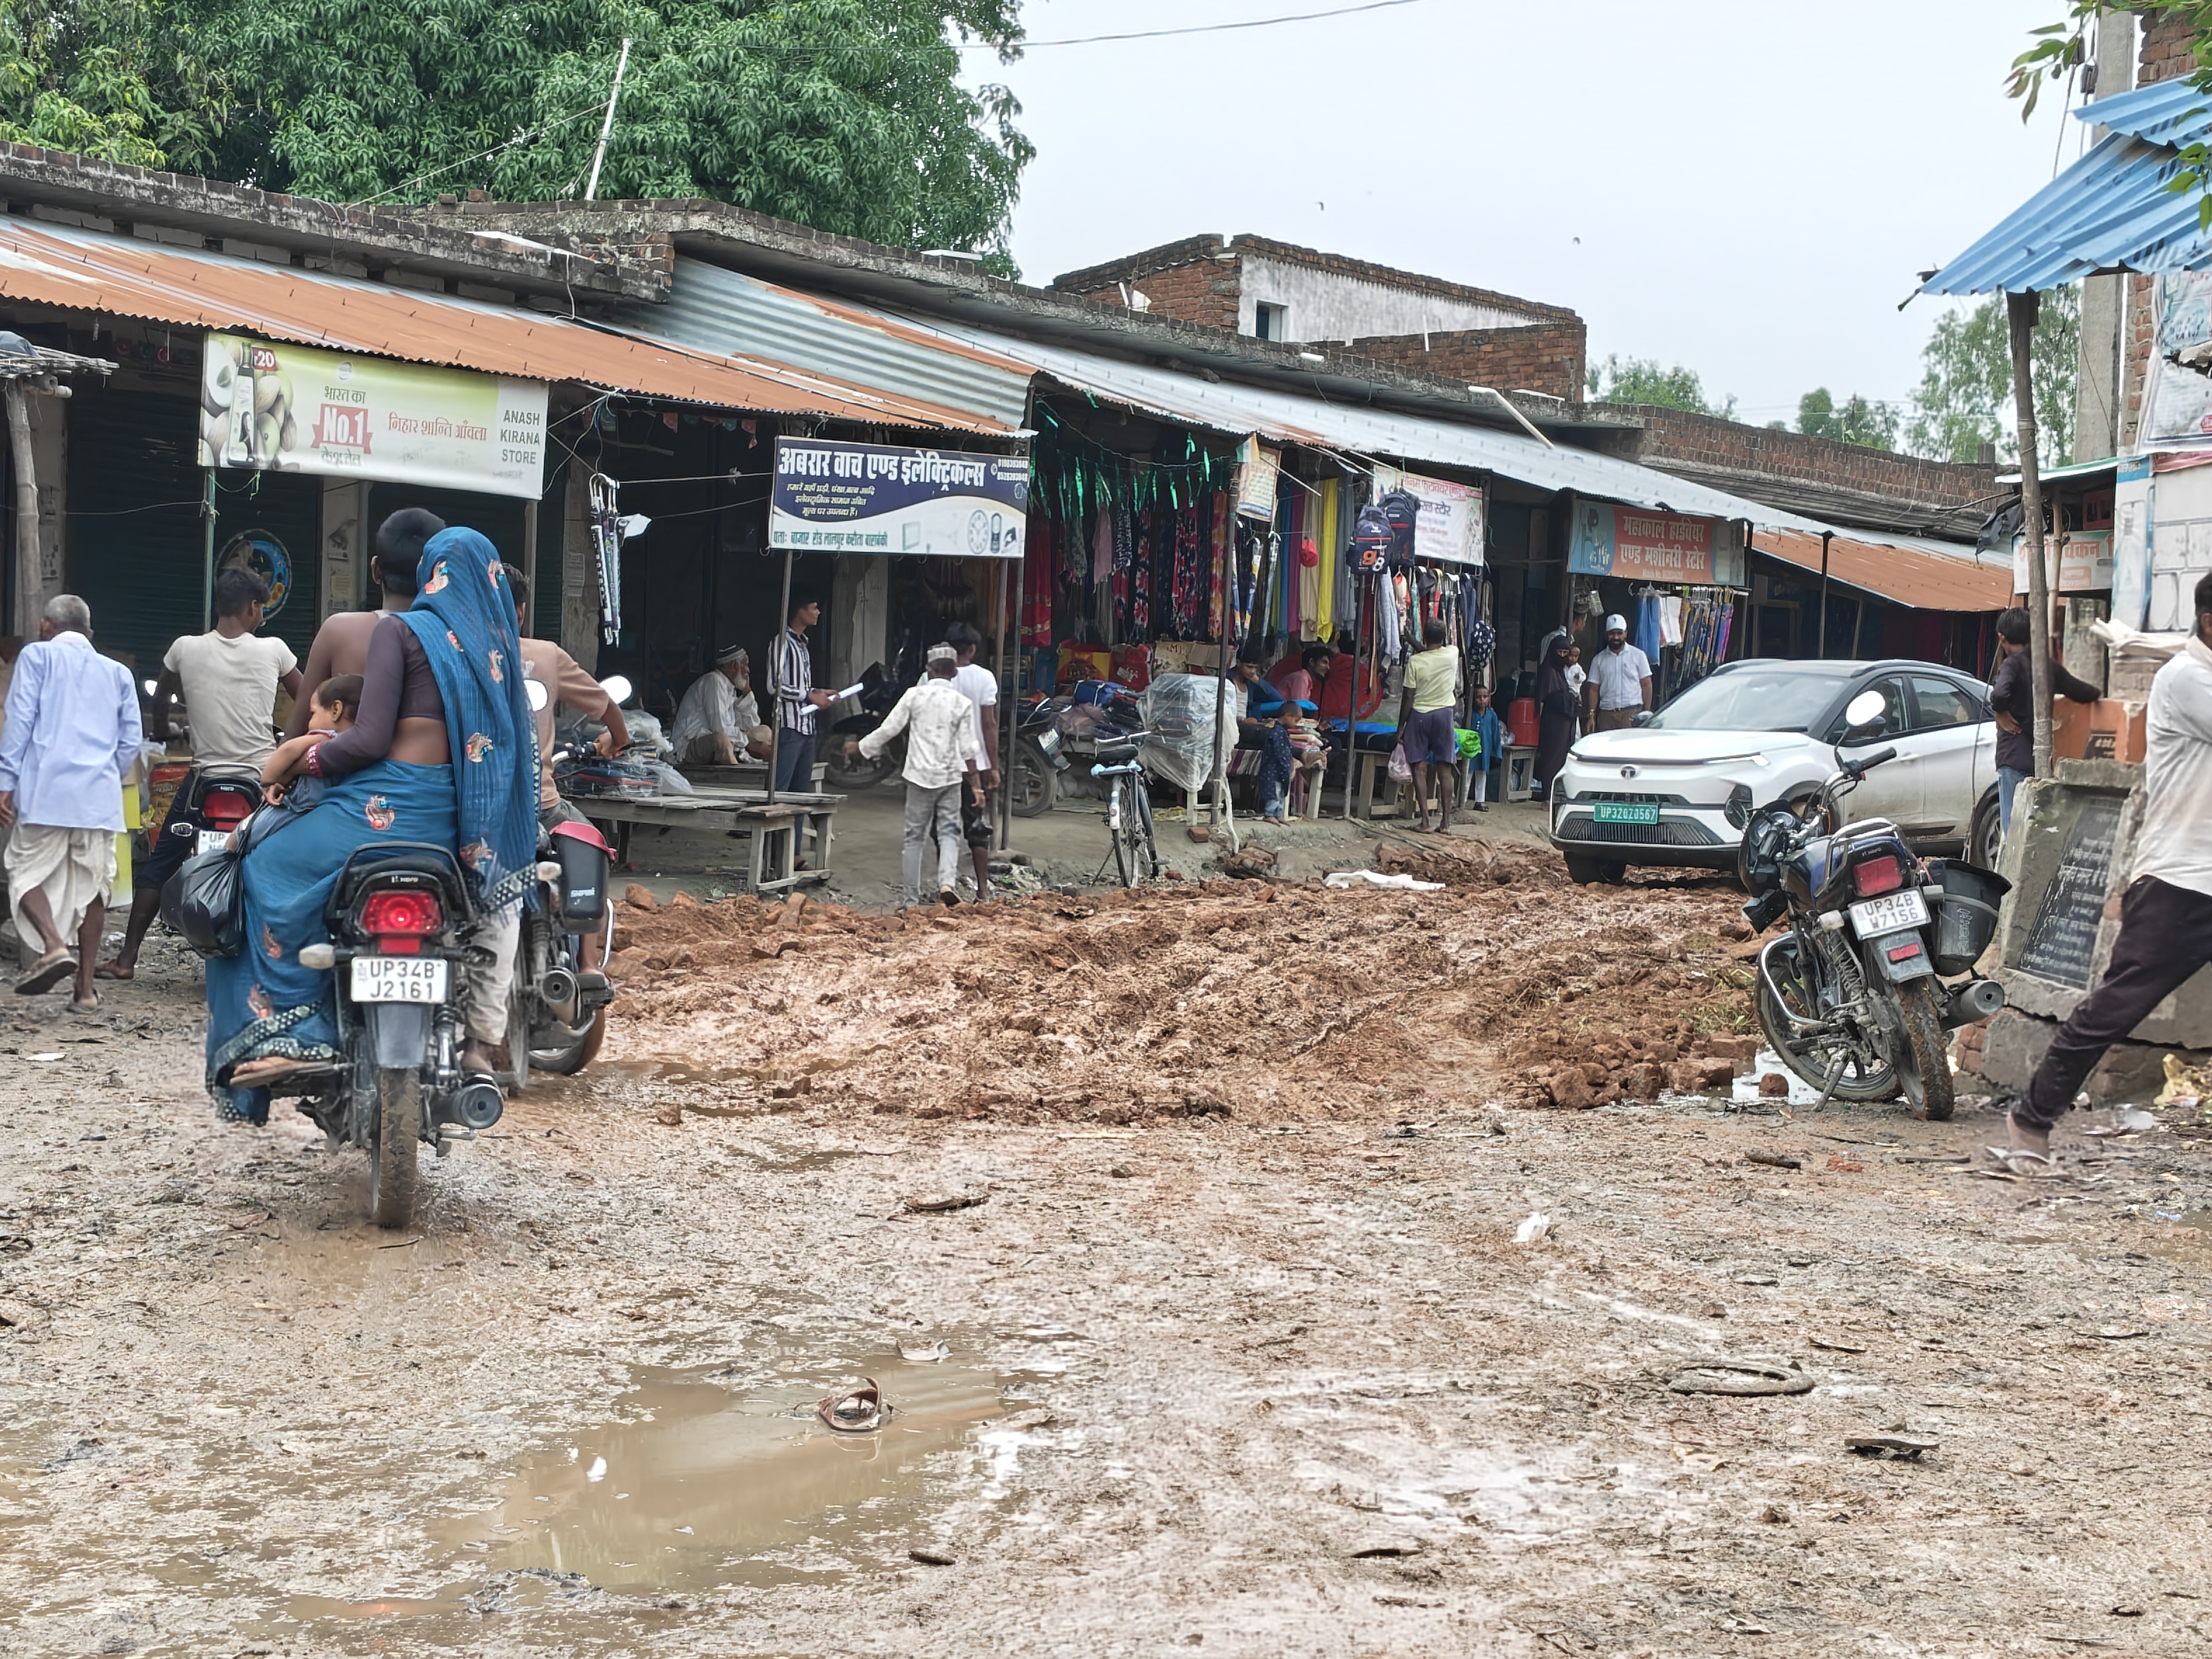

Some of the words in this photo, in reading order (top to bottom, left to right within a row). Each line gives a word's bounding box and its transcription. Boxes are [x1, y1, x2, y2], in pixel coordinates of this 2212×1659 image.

[325, 386, 349, 402] भारत
[352, 390, 366, 404] का
[389, 412, 418, 433] निहार
[421, 417, 453, 437] शान्ति
[503, 410, 539, 426] ANASH
[500, 429, 540, 446] KIRANA
[502, 449, 536, 464] STORE
[779, 447, 832, 476] अबरार
[834, 451, 864, 478] वाच
[867, 454, 899, 480] एण्ड
[1434, 501, 1452, 516] स्टोर
[1620, 543, 1642, 564] एण्ड
[1644, 542, 1683, 568] मशीनरी
[1686, 546, 1706, 570] स्टोर
[1865, 894, 1913, 915] UP34B
[1870, 908, 1918, 929] W7156
[370, 961, 435, 979] UP34B
[370, 980, 432, 999] J2161
